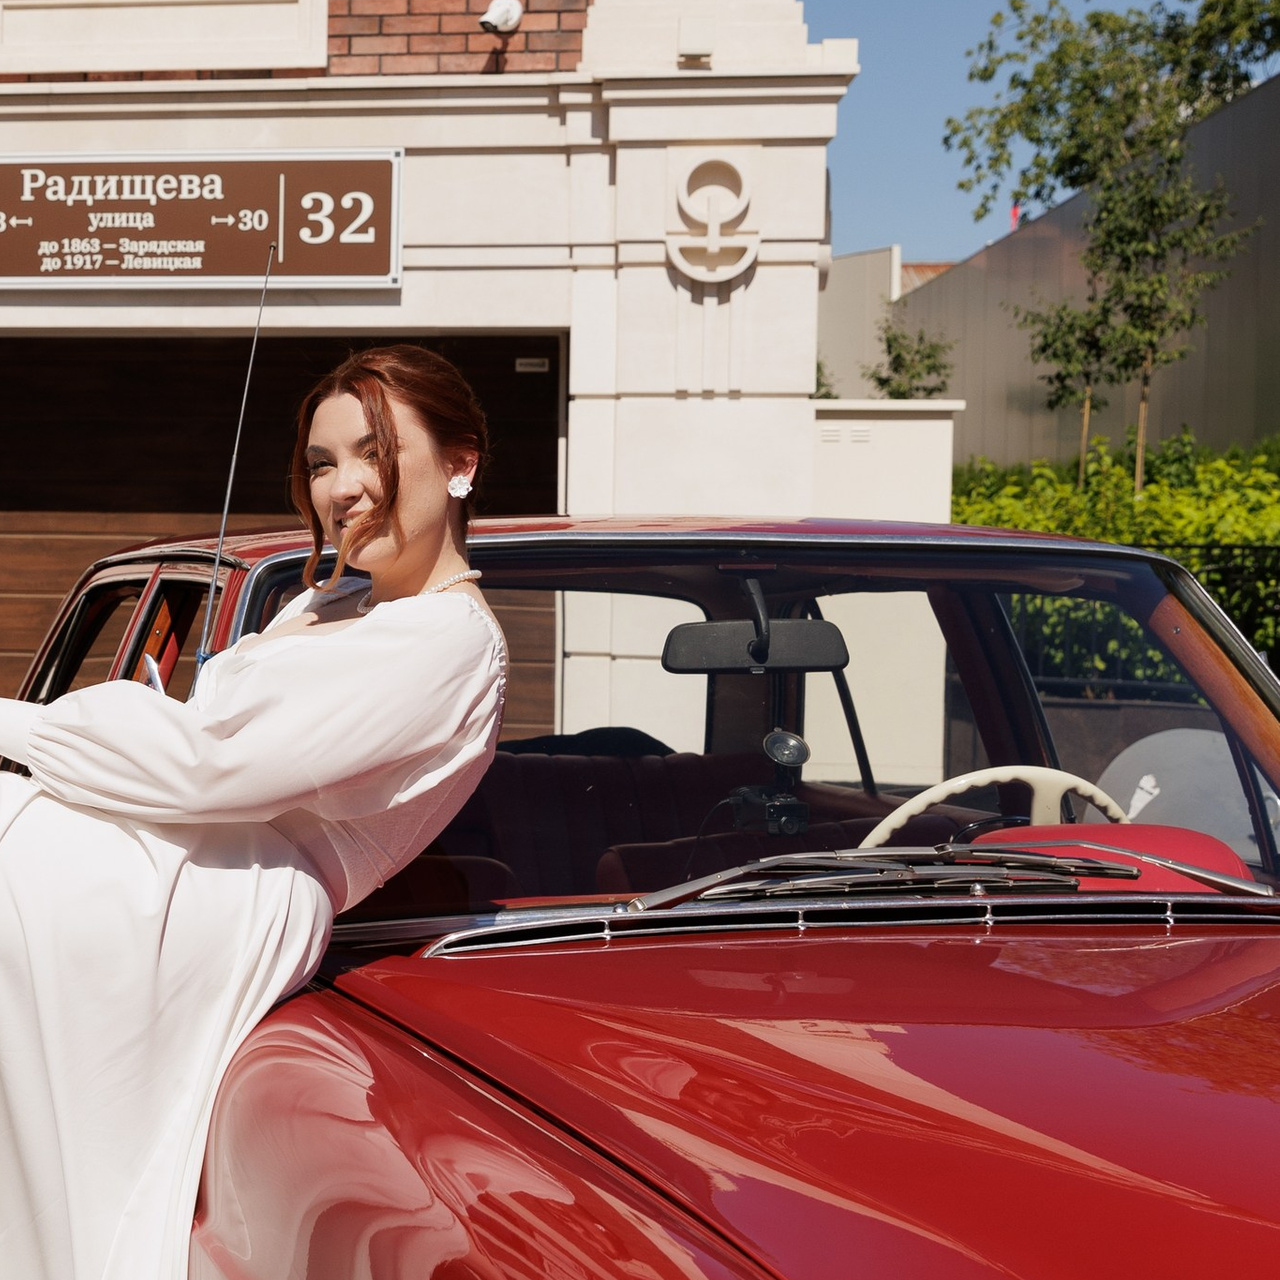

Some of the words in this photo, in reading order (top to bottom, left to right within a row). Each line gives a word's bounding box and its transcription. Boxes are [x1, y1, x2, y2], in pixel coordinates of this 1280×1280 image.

[20, 169, 224, 206] Радищева
[88, 211, 155, 232] улица
[238, 210, 269, 231] 30
[298, 191, 376, 244] 32
[38, 240, 59, 255] до
[61, 238, 100, 253] 1863
[119, 237, 205, 255] Зарядская
[40, 257, 61, 271] до
[63, 255, 103, 270] 1917
[121, 255, 202, 271] Левицкая
